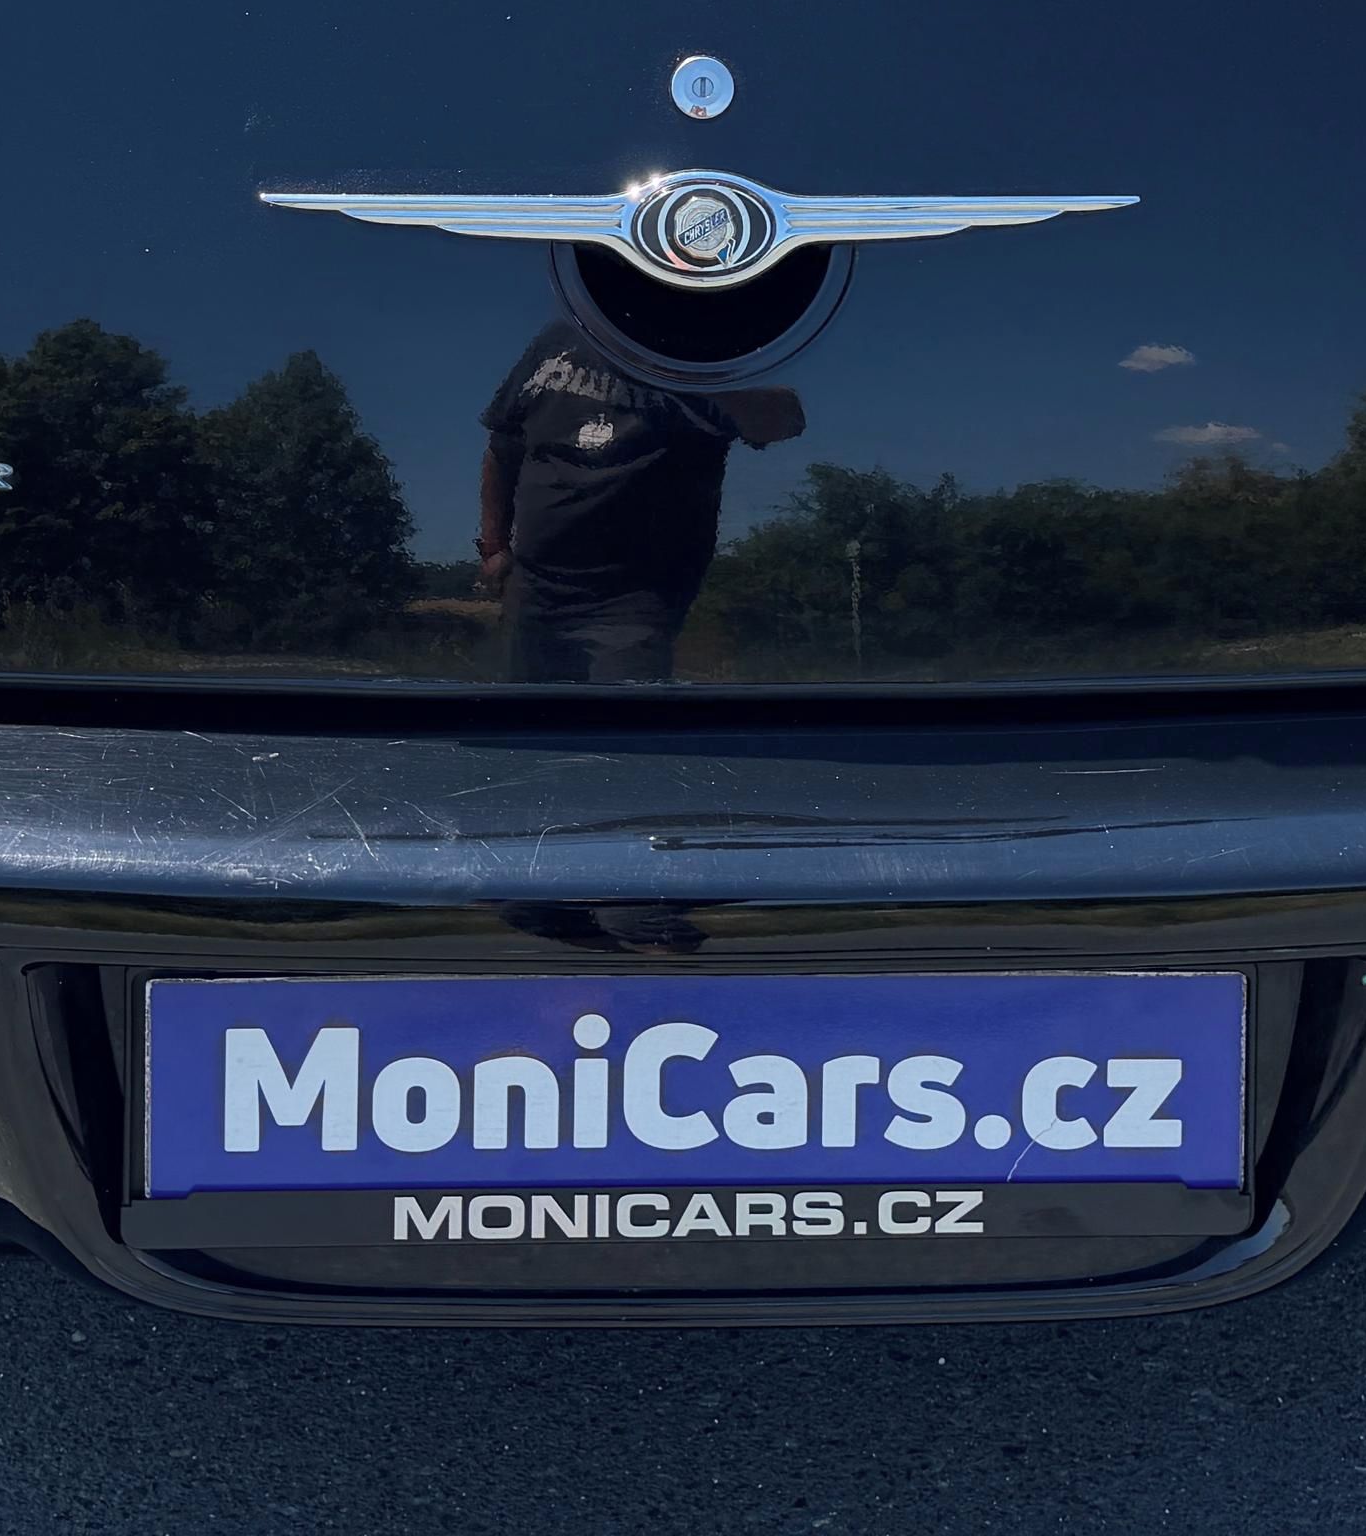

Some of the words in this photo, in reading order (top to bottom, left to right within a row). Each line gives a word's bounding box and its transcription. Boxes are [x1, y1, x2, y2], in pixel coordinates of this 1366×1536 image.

[684, 209, 727, 245] CHRYSLER
[223, 1014, 1184, 1153] MoniCars.cz
[393, 1190, 984, 1241] MONICARS.CZ
